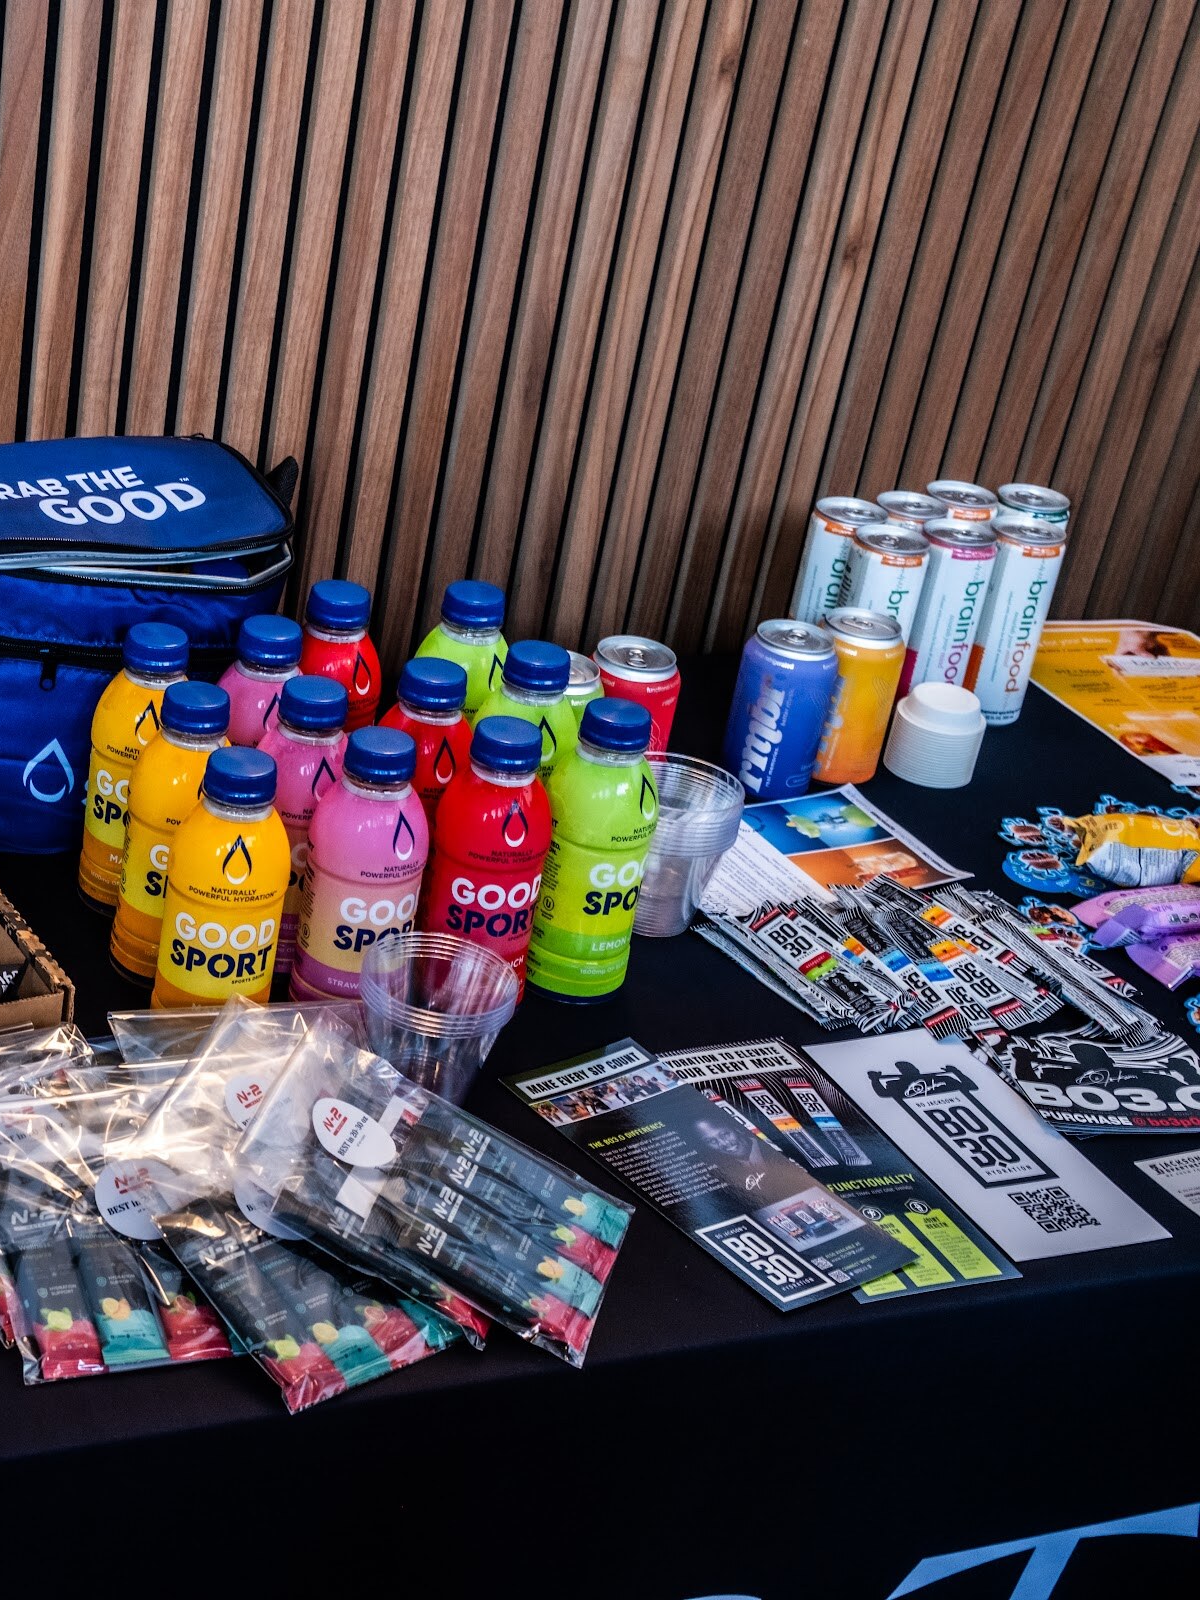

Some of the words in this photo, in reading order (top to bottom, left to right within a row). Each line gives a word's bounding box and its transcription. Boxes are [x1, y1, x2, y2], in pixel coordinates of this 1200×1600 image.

[65, 466, 144, 493] THE
[944, 580, 985, 684] brainfo
[1004, 580, 1047, 693] brainfood
[740, 673, 785, 794] rmbr
[611, 835, 648, 843] POWERFUL
[468, 851, 510, 865] POWERFUL
[490, 849, 533, 857] NATURALLY
[360, 870, 401, 880] POWERFUL
[384, 860, 420, 873] NATURALLY
[188, 885, 231, 902] POWERFUL
[211, 887, 256, 896] NATURALLY
[451, 874, 542, 910] GOOD
[446, 904, 536, 938] SPORT
[175, 912, 275, 950] GOOD
[768, 922, 799, 946] BO
[592, 939, 626, 952] LEMON
[170, 939, 272, 978] SPORT
[971, 977, 1001, 999] BO
[960, 1004, 987, 1021] BO
[721, 1053, 735, 1061] TO
[735, 1046, 781, 1059] ELEVATE
[526, 1080, 560, 1095] MAKE
[561, 1070, 589, 1086] EVERY
[588, 1064, 605, 1076] SIP
[605, 1052, 640, 1070] COUNT
[677, 1065, 706, 1080] OUR
[708, 1060, 750, 1075] EVERY
[753, 1055, 793, 1069] MOVE
[752, 1095, 774, 1106] BO
[797, 1092, 818, 1103] BO
[927, 1097, 961, 1107] JACKSON'S
[923, 1105, 989, 1137] BO
[1039, 1109, 1133, 1126] PURCHASE
[588, 1140, 604, 1150] THE
[626, 1121, 666, 1139] DIFFERENCE
[338, 1141, 351, 1156] BEST
[985, 1164, 1032, 1176] HYDRATION
[827, 1173, 915, 1192] FUNCTIONALITY
[107, 1201, 132, 1216] BEST
[722, 1232, 775, 1262] BO
[782, 1277, 815, 1291] HYDRATION
